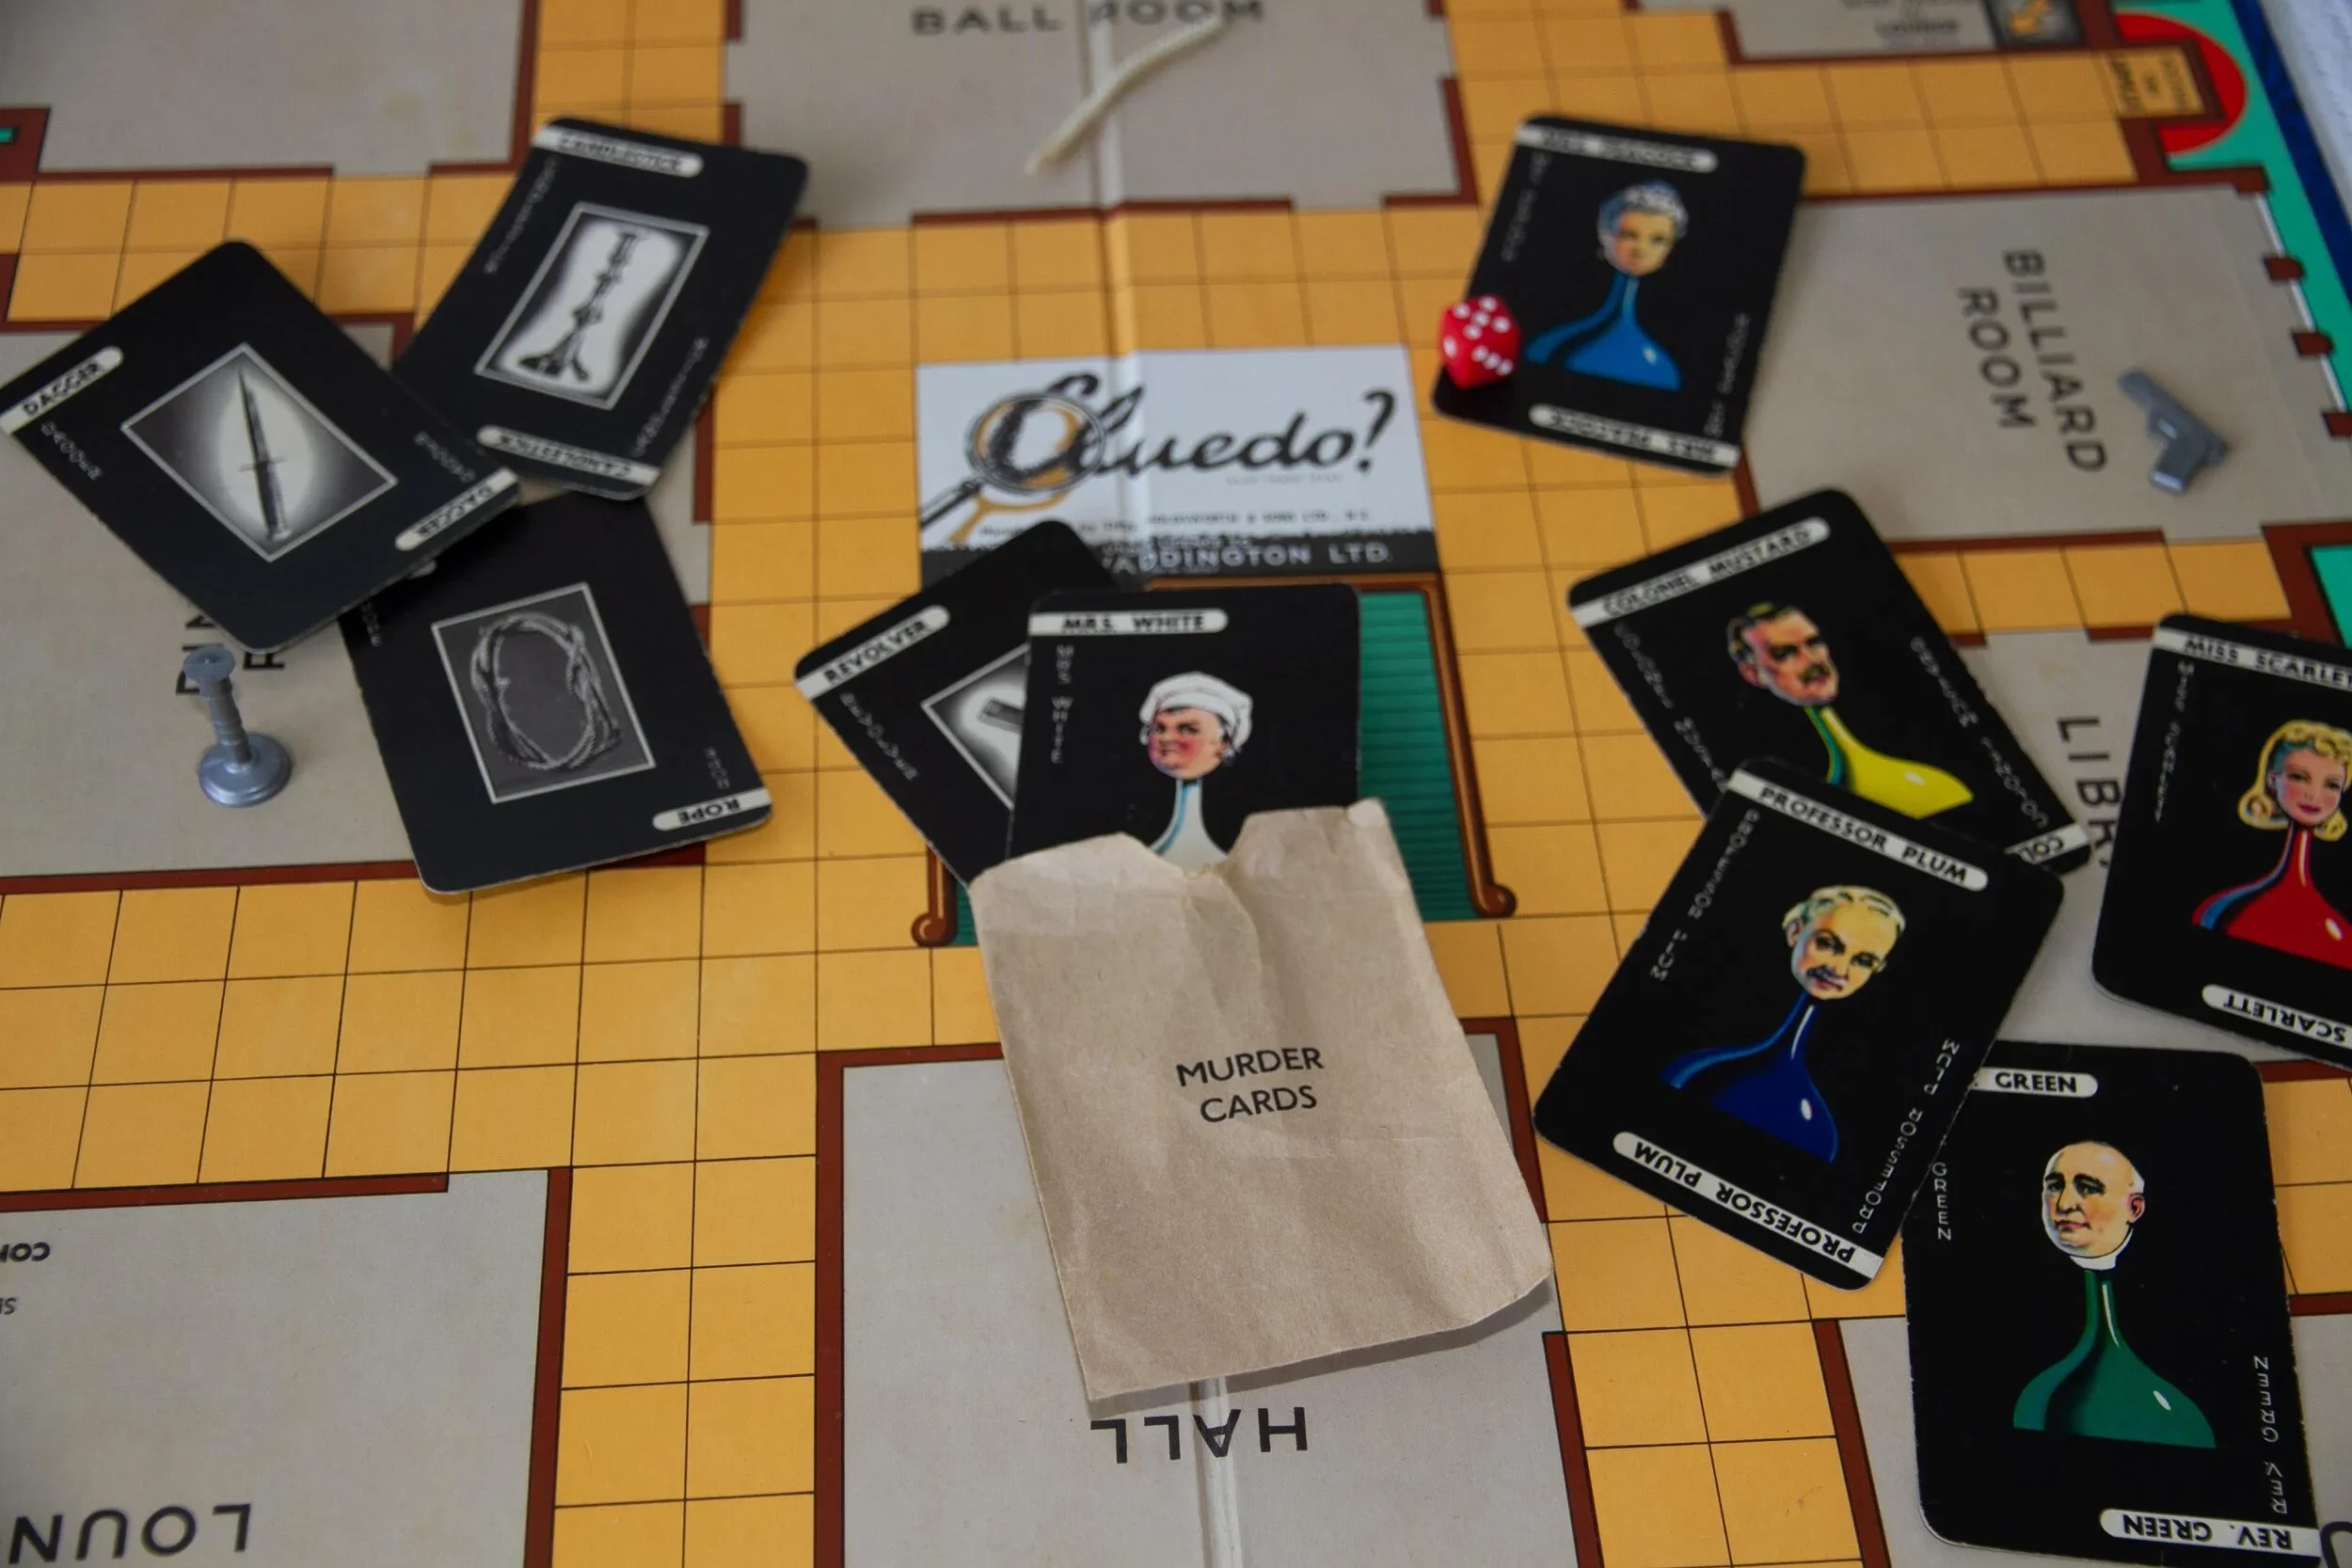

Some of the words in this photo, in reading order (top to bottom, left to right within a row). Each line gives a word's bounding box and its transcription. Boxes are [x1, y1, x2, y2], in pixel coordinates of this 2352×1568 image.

[911, 5, 1063, 36] BALL
[1957, 286, 2039, 429] ROOM
[2002, 249, 2108, 472] BILLIARD
[1708, 528, 1811, 577] MUSTARD
[1133, 614, 1204, 632] WHITE
[823, 620, 926, 684] REVOLVER
[2185, 636, 2239, 663] MISS
[676, 798, 740, 824] ROPE
[2058, 717, 2122, 867] LIBR
[1759, 785, 1887, 853] PROFESSOR
[1900, 845, 1967, 883] PLUM
[2223, 993, 2346, 1042] SCARLETT
[1176, 1047, 1325, 1087] MURDER
[1994, 1071, 2077, 1093] GREEN
[1200, 1085, 1317, 1123] CARDS
[1851, 1107, 1924, 1235] PROFESSOR
[1923, 1037, 1961, 1096] PLUM
[1632, 1141, 1702, 1188] PLUM
[1715, 1181, 1856, 1264] PROFESSOR
[1931, 1162, 1952, 1241] GREEN
[2253, 1354, 2279, 1443] GREEN
[1089, 1406, 1308, 1465] HALL
[2122, 1513, 2214, 1543] GREEN
[2229, 1523, 2294, 1550] REV.
